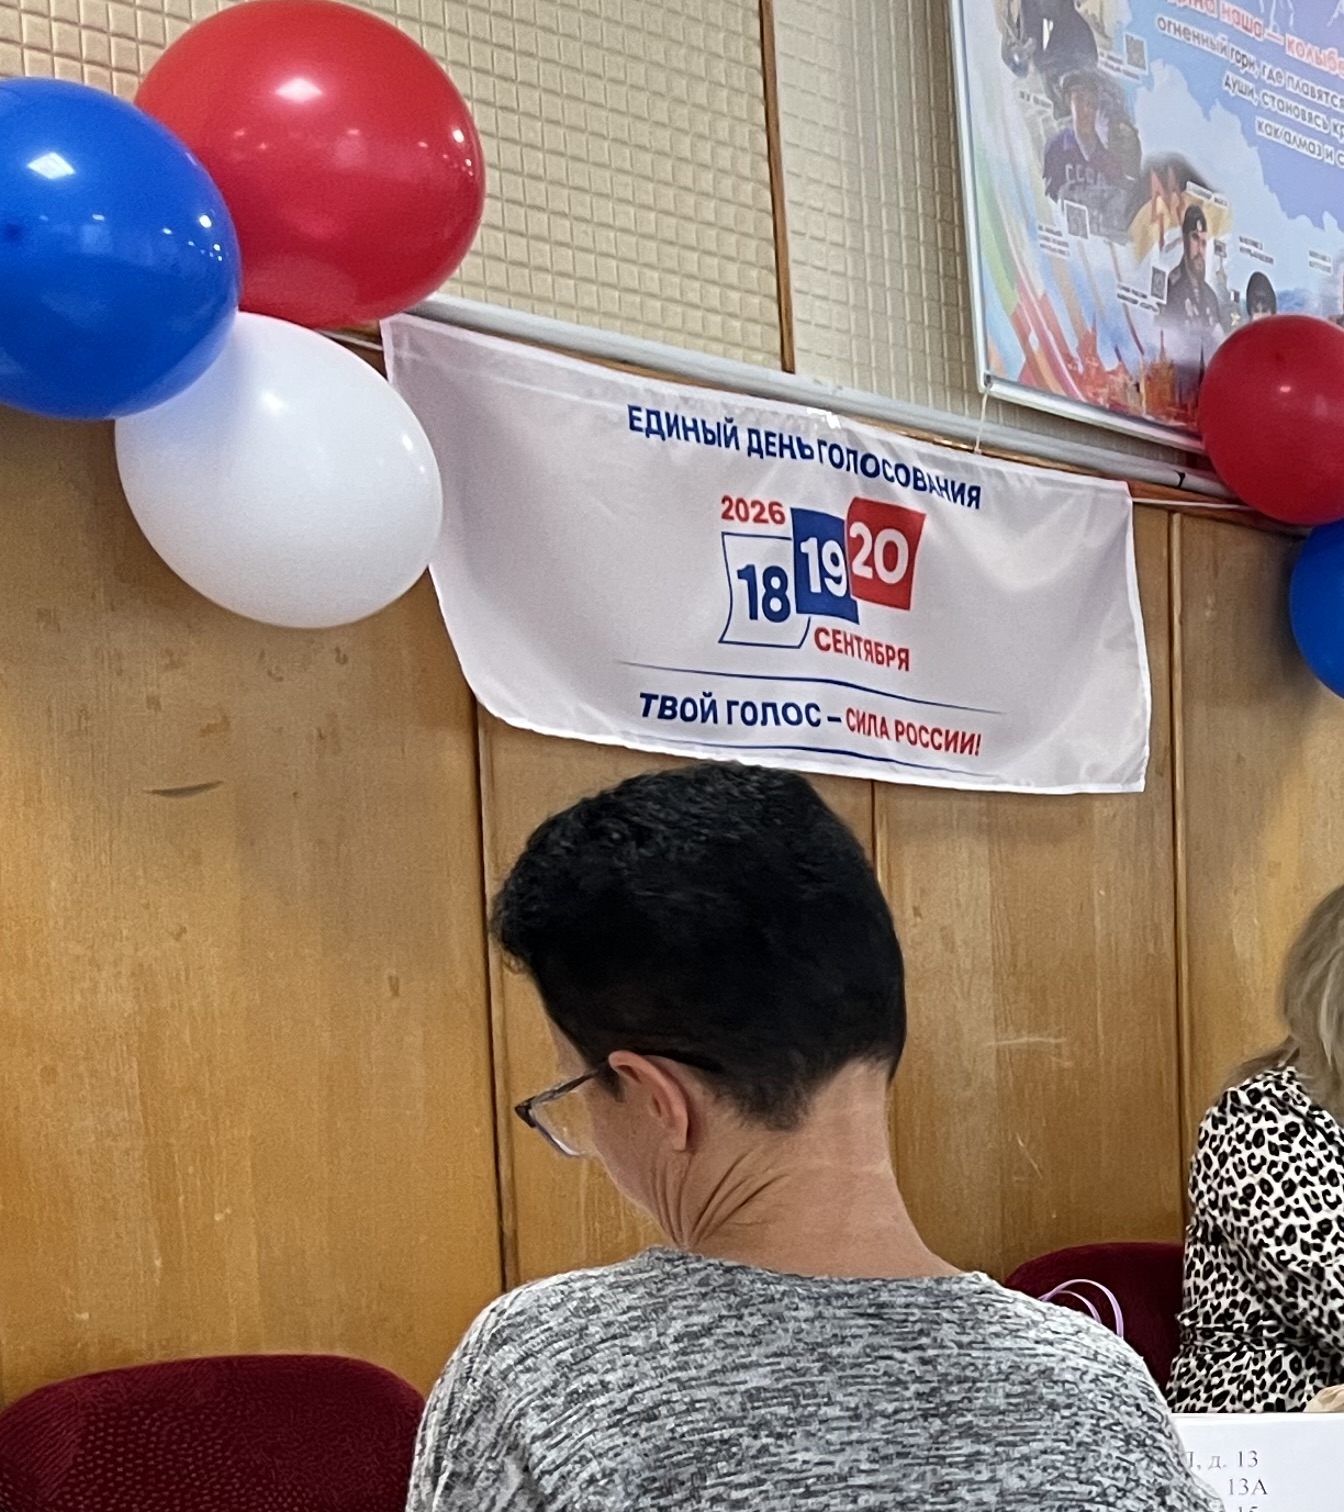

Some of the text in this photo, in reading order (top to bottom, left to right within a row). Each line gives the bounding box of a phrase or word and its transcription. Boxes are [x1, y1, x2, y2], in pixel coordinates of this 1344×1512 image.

[1157, 17, 1227, 54] огненный
[1263, 64, 1283, 84] где
[1262, 92, 1329, 130] становясь
[1257, 121, 1280, 138] как
[1284, 132, 1323, 159] алмаз
[627, 404, 982, 510] ЕДИНЫЙ ДЕНЬ ГОЛОСОВАНИЯ
[720, 495, 786, 525] 2026
[736, 521, 910, 623] 18 19 20
[814, 627, 911, 672] СЕНТЯБРЯ
[639, 691, 719, 725] ТВОЙ
[726, 699, 822, 728] ГОЛОС
[846, 707, 890, 741] СИЛА
[894, 718, 983, 757] РОССИИ!
[1207, 1455, 1227, 1471] д.
[1238, 1449, 1258, 1468] 13
[1229, 1477, 1268, 1496] 13А
